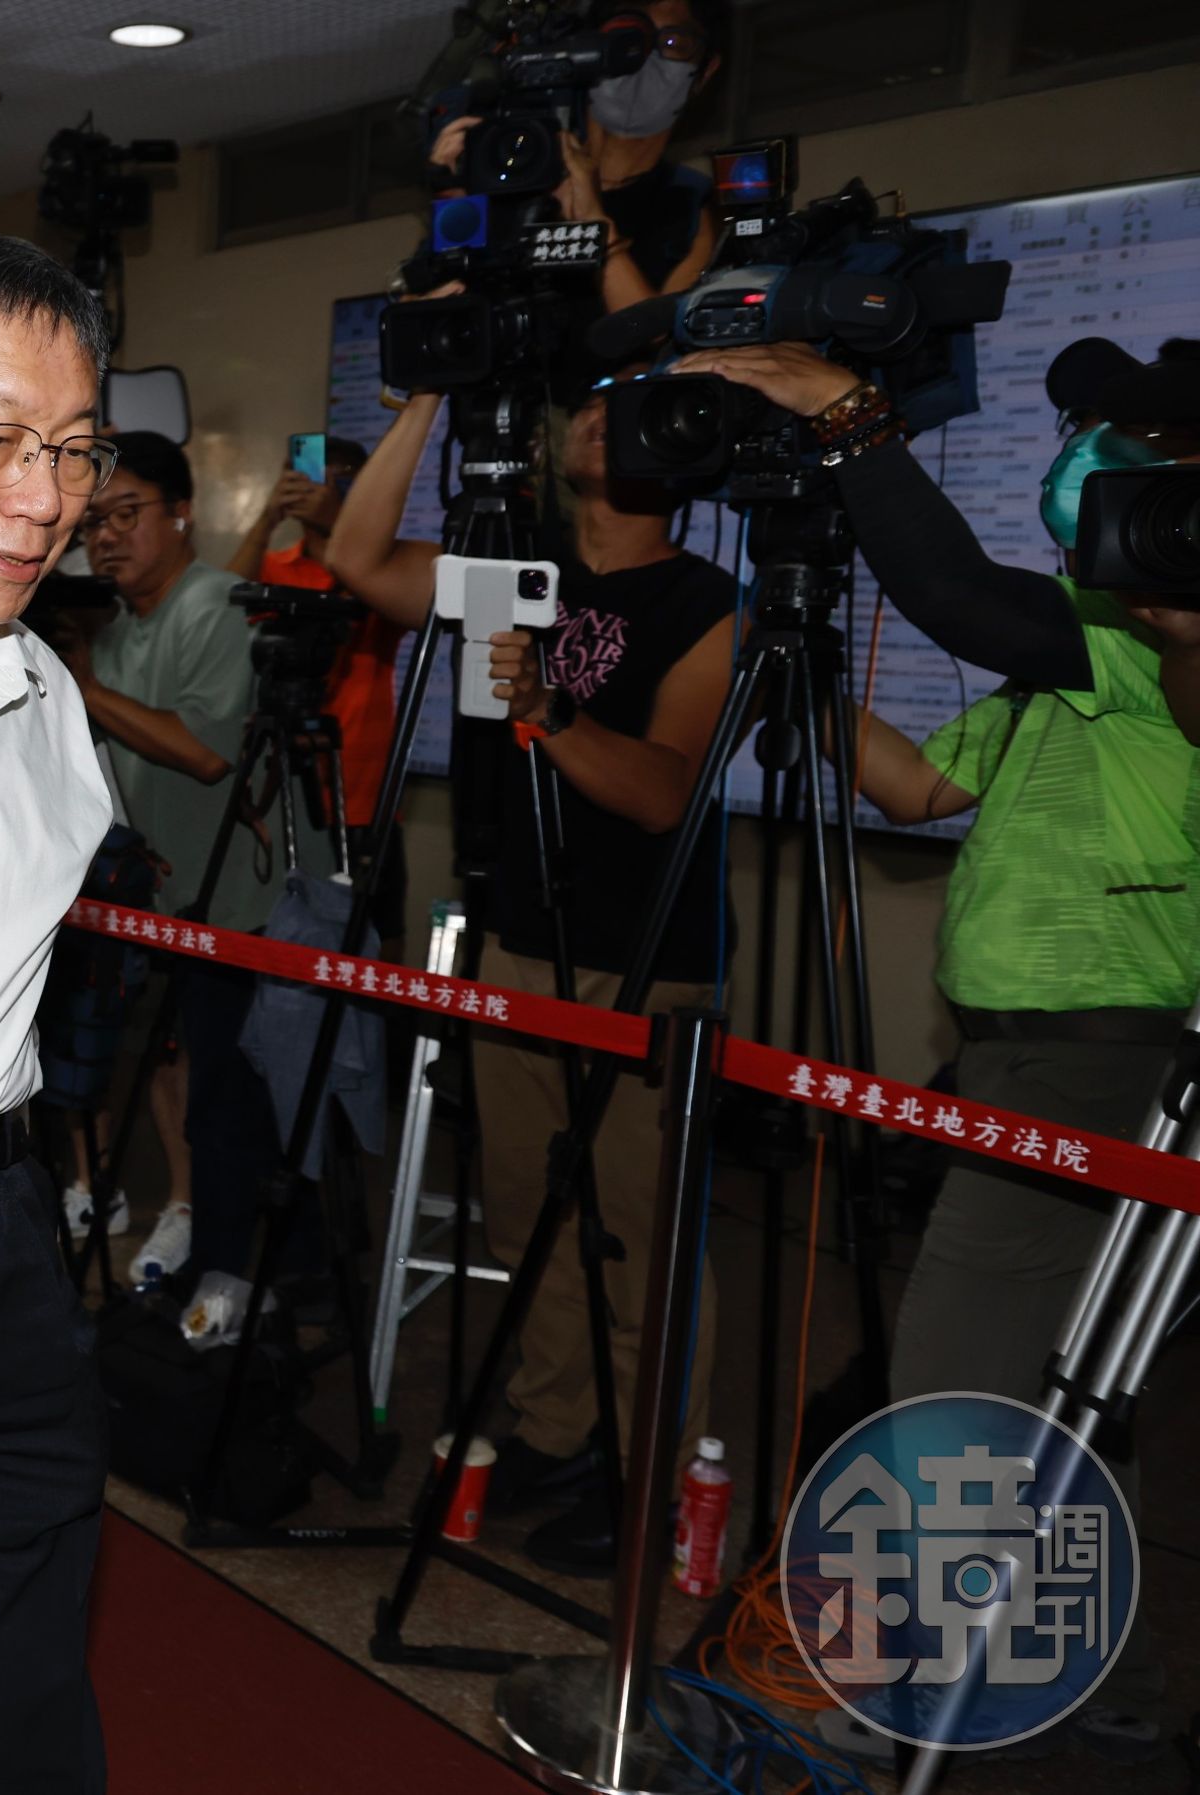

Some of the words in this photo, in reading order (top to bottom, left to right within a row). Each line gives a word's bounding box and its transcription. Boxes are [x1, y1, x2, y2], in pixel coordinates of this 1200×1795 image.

[313, 955, 509, 1021] 臺灣臺北地方法院
[788, 1063, 1090, 1173] 臺灣臺北地方法院
